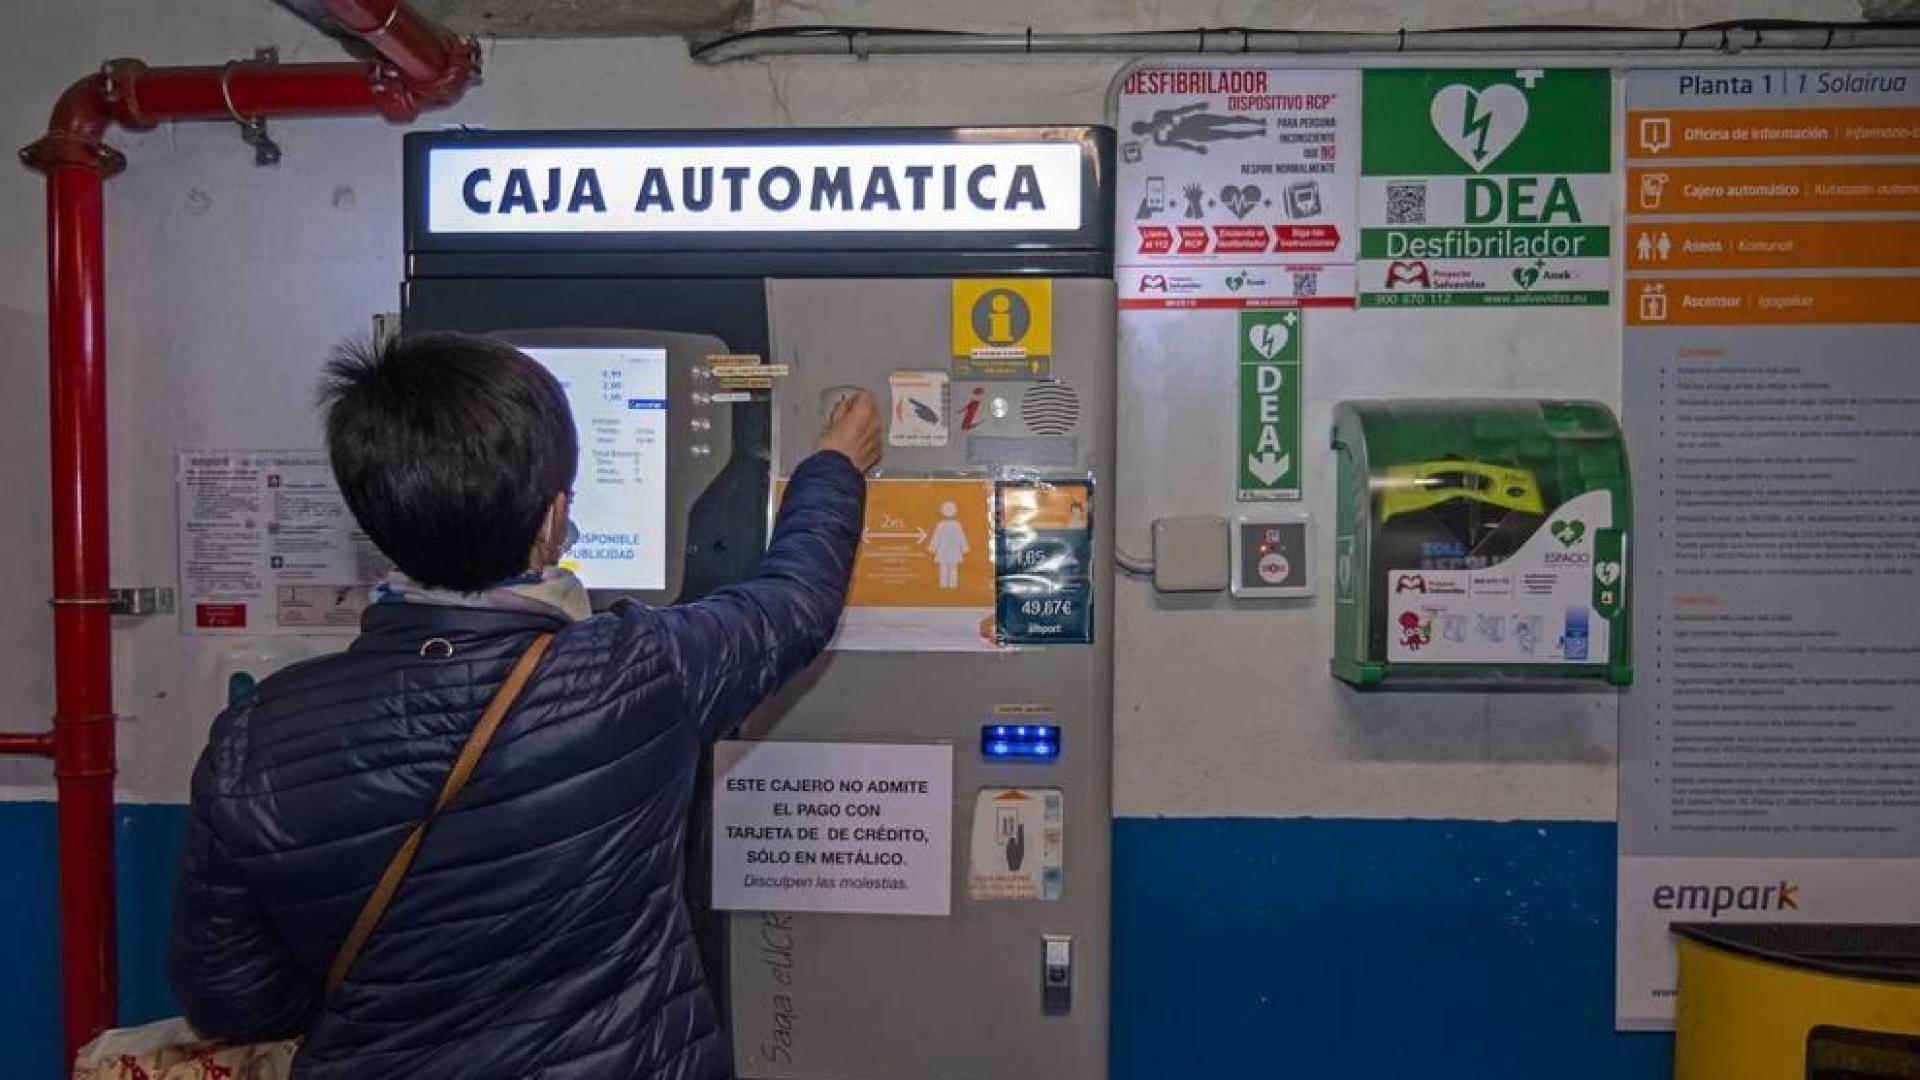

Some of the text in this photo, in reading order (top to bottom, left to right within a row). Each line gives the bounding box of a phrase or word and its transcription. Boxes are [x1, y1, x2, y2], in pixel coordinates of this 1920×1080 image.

[1124, 71, 1268, 94] DESFIBRILADOR
[1679, 72, 1907, 95] Planta 1 1 Solairua
[1228, 94, 1303, 111] DISPOSITIVO
[1684, 127, 1729, 141] Oficina
[1732, 127, 1749, 141] de
[1751, 126, 1828, 141] información
[462, 164, 1046, 214] CAJA AUTOMATICA
[1683, 184, 1724, 200] Cajero
[1726, 182, 1799, 197] automático
[1464, 177, 1582, 224] DEA
[1385, 228, 1586, 257] Desfibrilador
[1683, 239, 1722, 252] Aseos
[1682, 294, 1741, 308] Ascensor
[1256, 366, 1283, 452] DEA
[726, 778, 929, 794] ESTE CAJERO NO ADMITE
[773, 803, 881, 817] EL PAGO CON
[726, 824, 930, 844] TARJETA DE DE CRÉDITO,
[746, 848, 908, 866] SÓLO EN METÁLICO.
[744, 873, 909, 891] Disculpen las molestias.
[1652, 880, 1799, 918] empark
